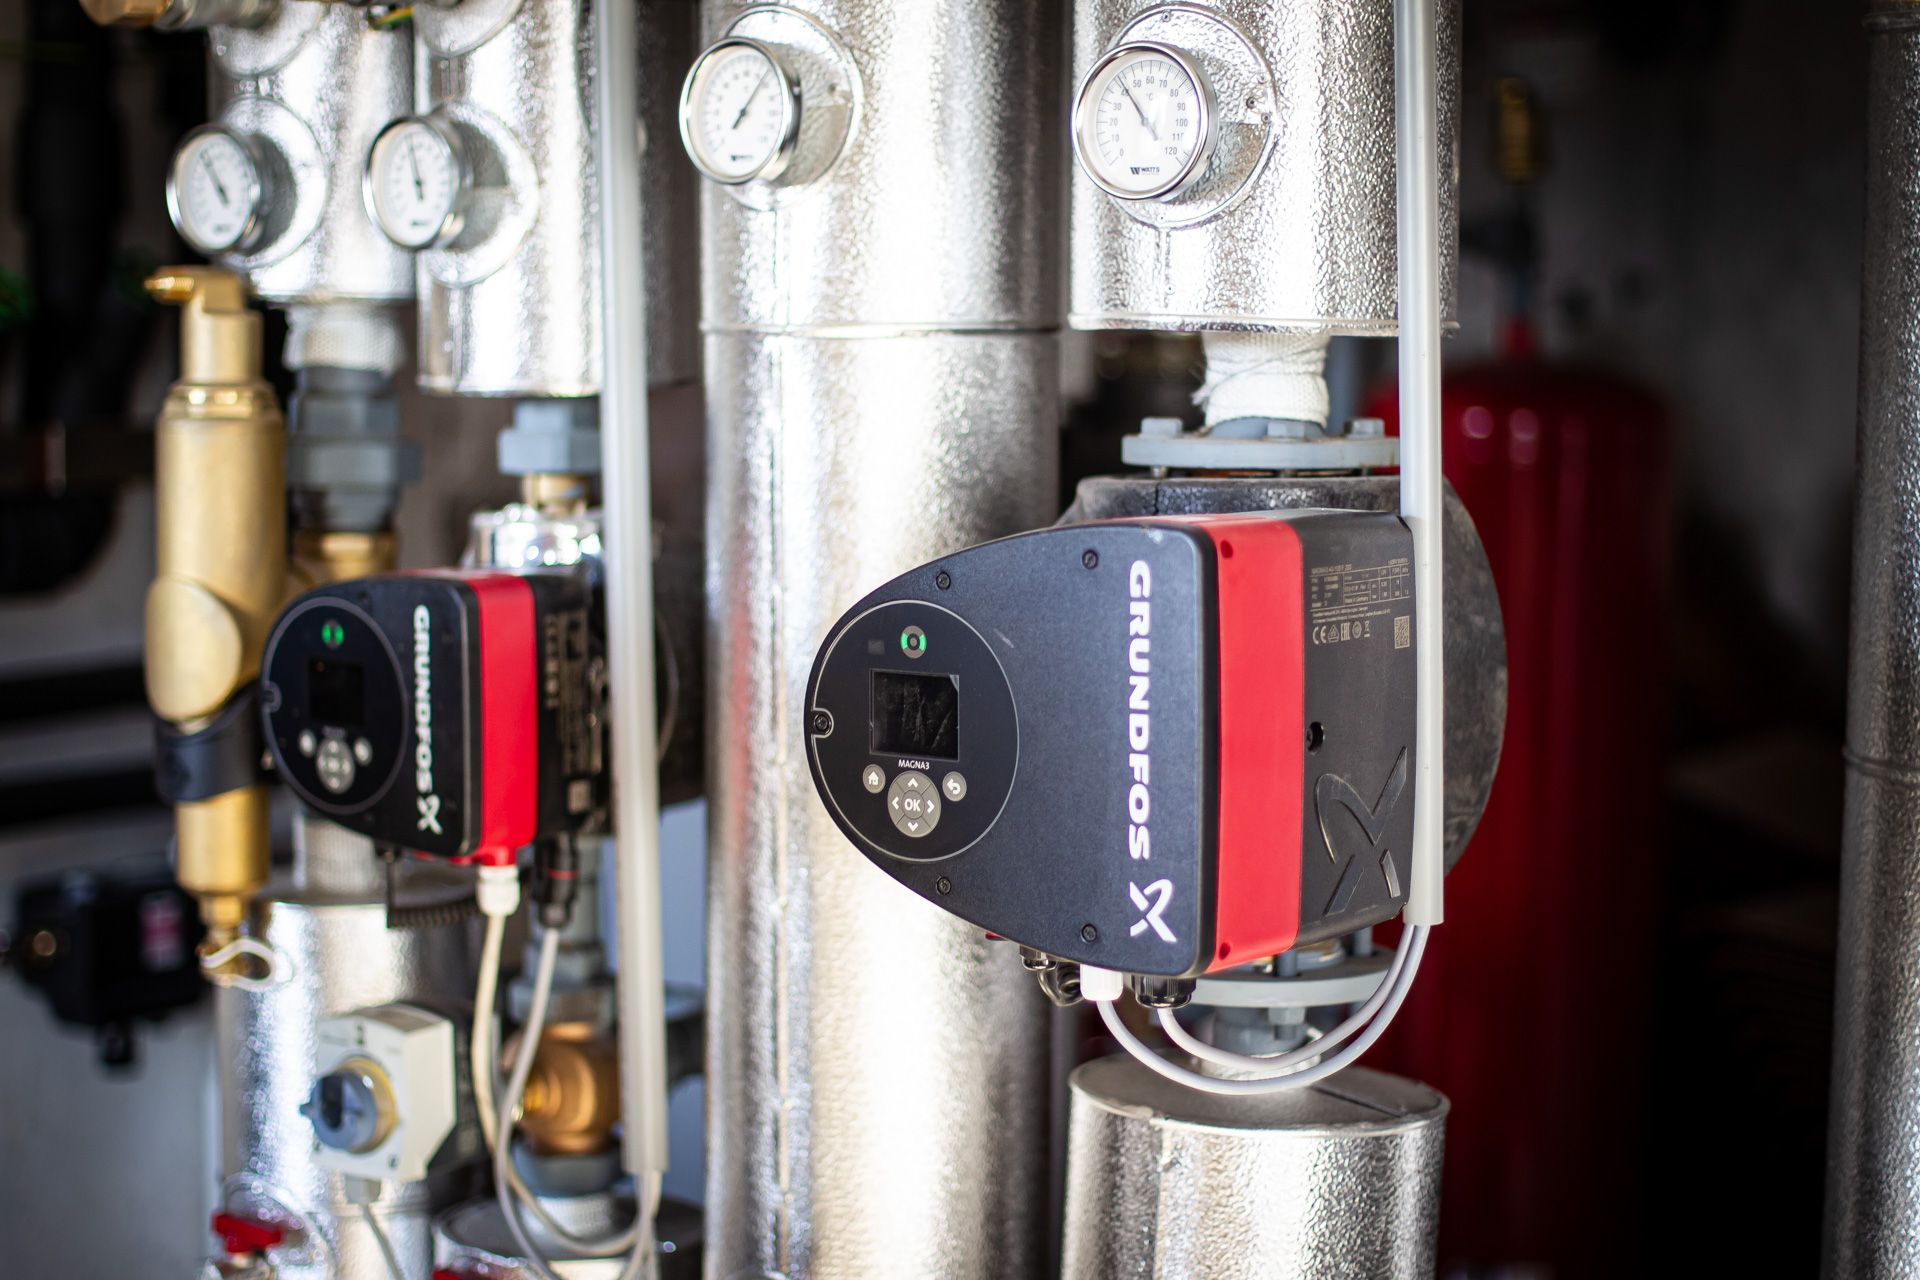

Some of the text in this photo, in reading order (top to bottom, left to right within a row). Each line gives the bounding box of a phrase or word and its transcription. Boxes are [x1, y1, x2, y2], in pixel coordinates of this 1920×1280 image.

[1133, 80, 1141, 88] 50
[1146, 76, 1155, 84] 60
[1159, 80, 1168, 88] 70
[1170, 89, 1179, 97] 80
[1113, 102, 1122, 111] 30
[1177, 102, 1186, 111] 90
[1110, 118, 1118, 126] 20
[1176, 118, 1188, 127] 100
[1111, 134, 1120, 142] 10
[1120, 148, 1124, 157] 0
[1165, 146, 1178, 155] 120
[413, 604, 433, 793] GRUNDFOS
[1129, 560, 1151, 860] GRUNDFOS
[898, 759, 930, 770] MAGNA3
[904, 798, 921, 811] OK
